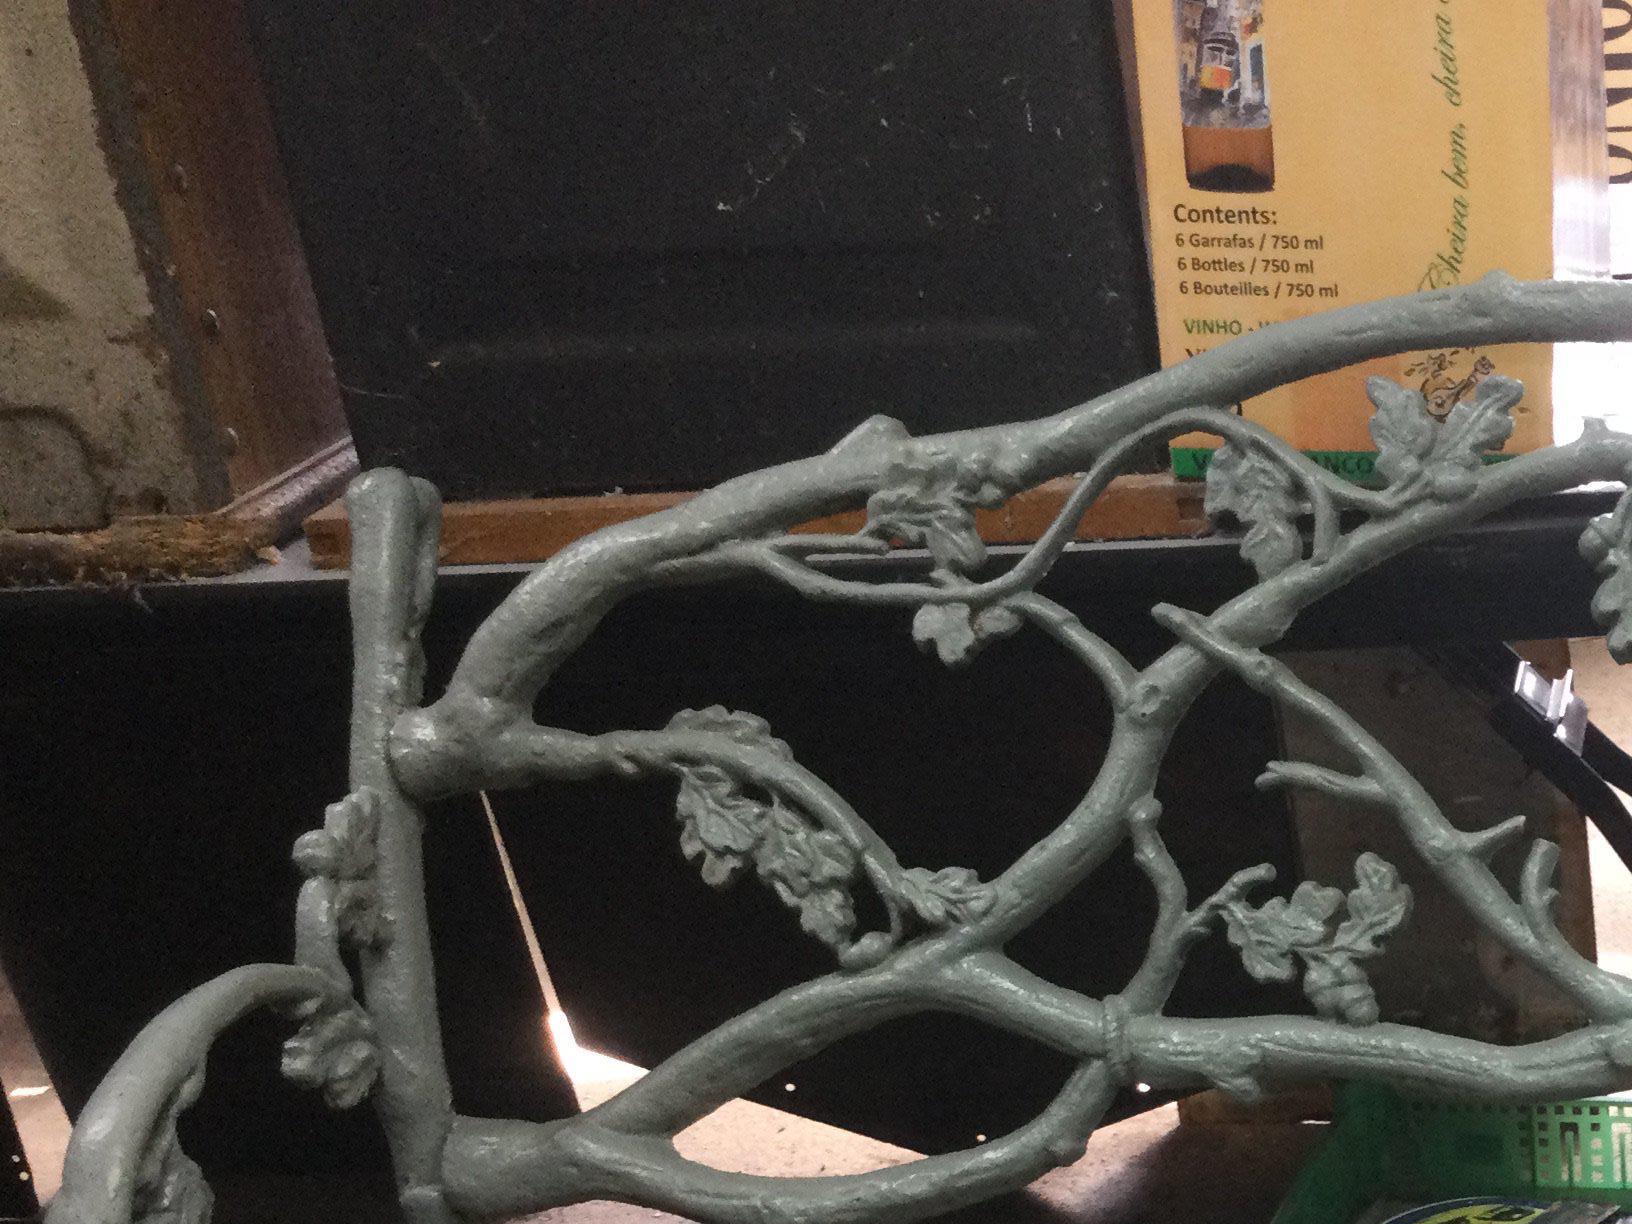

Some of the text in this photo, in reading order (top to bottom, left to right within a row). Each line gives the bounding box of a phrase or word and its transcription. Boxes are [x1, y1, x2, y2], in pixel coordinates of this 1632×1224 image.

[1173, 203, 1277, 225] Contents:
[1175, 232, 1324, 251] 6 Garrafas / 750 ml
[1177, 257, 1314, 275] 6 Bottles / 750 ml
[1179, 280, 1338, 299] 6 Bouteilles / 750 ml
[1183, 318, 1243, 336] VINHO
